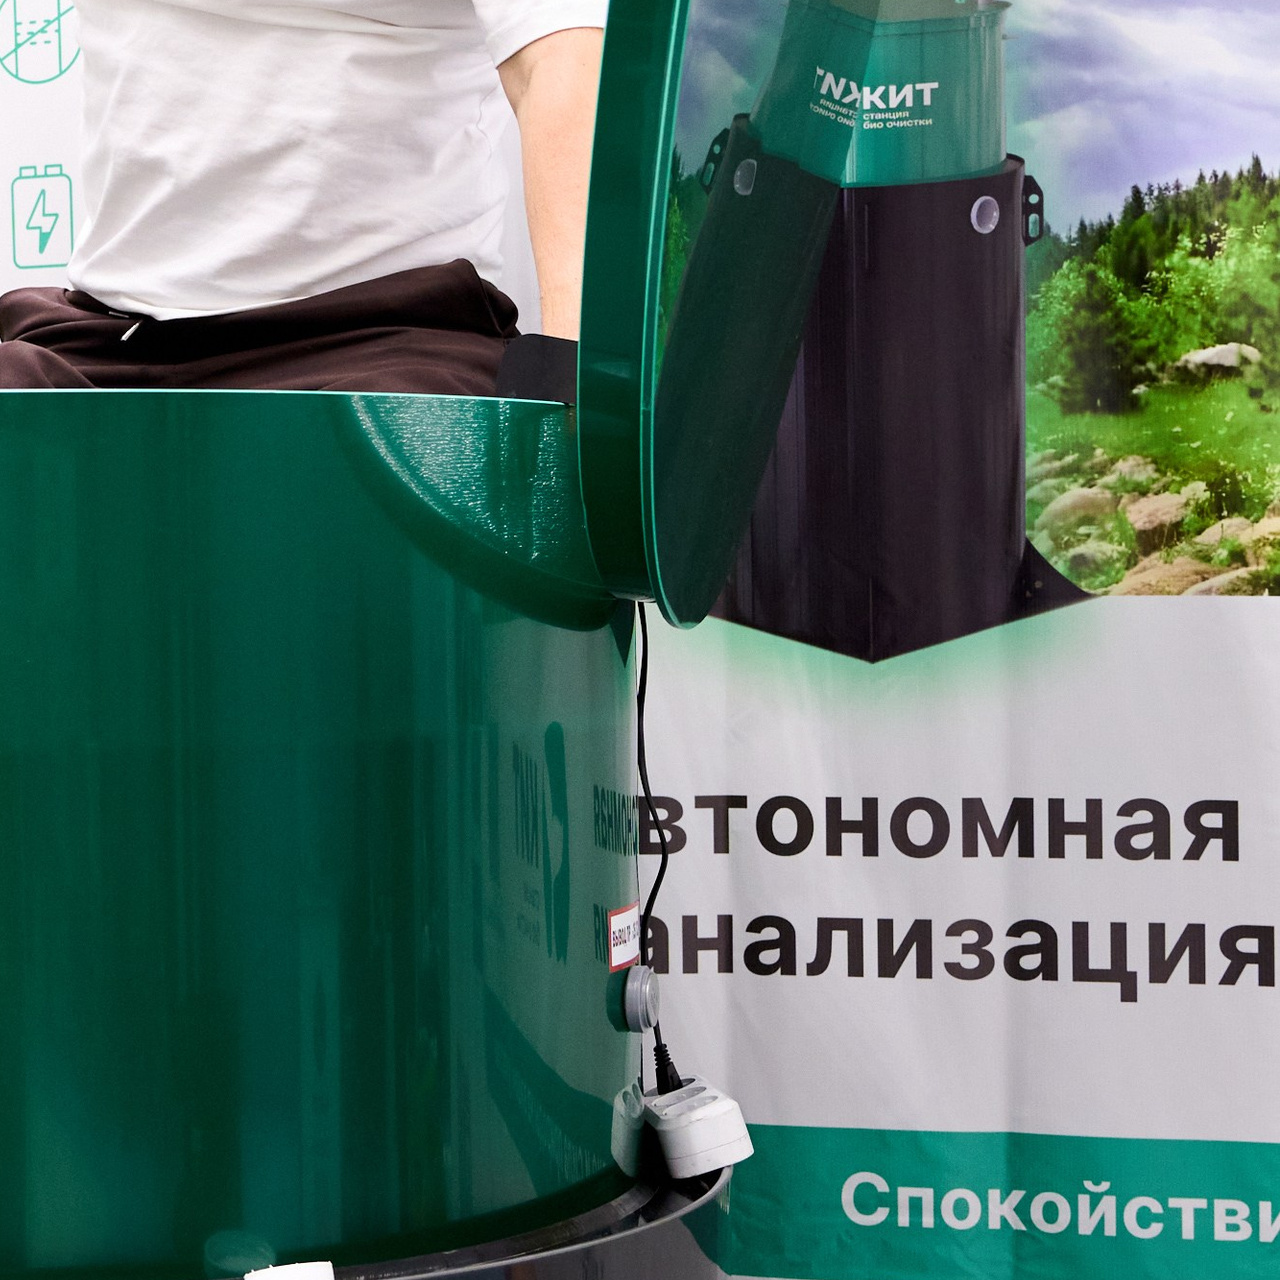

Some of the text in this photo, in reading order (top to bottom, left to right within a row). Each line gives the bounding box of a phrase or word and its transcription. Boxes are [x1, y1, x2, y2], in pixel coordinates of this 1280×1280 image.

[862, 81, 939, 110] КИТ
[863, 111, 910, 120] станция
[863, 118, 933, 130] био очистки
[638, 795, 1239, 862] втономная
[641, 913, 1276, 1003] анализация
